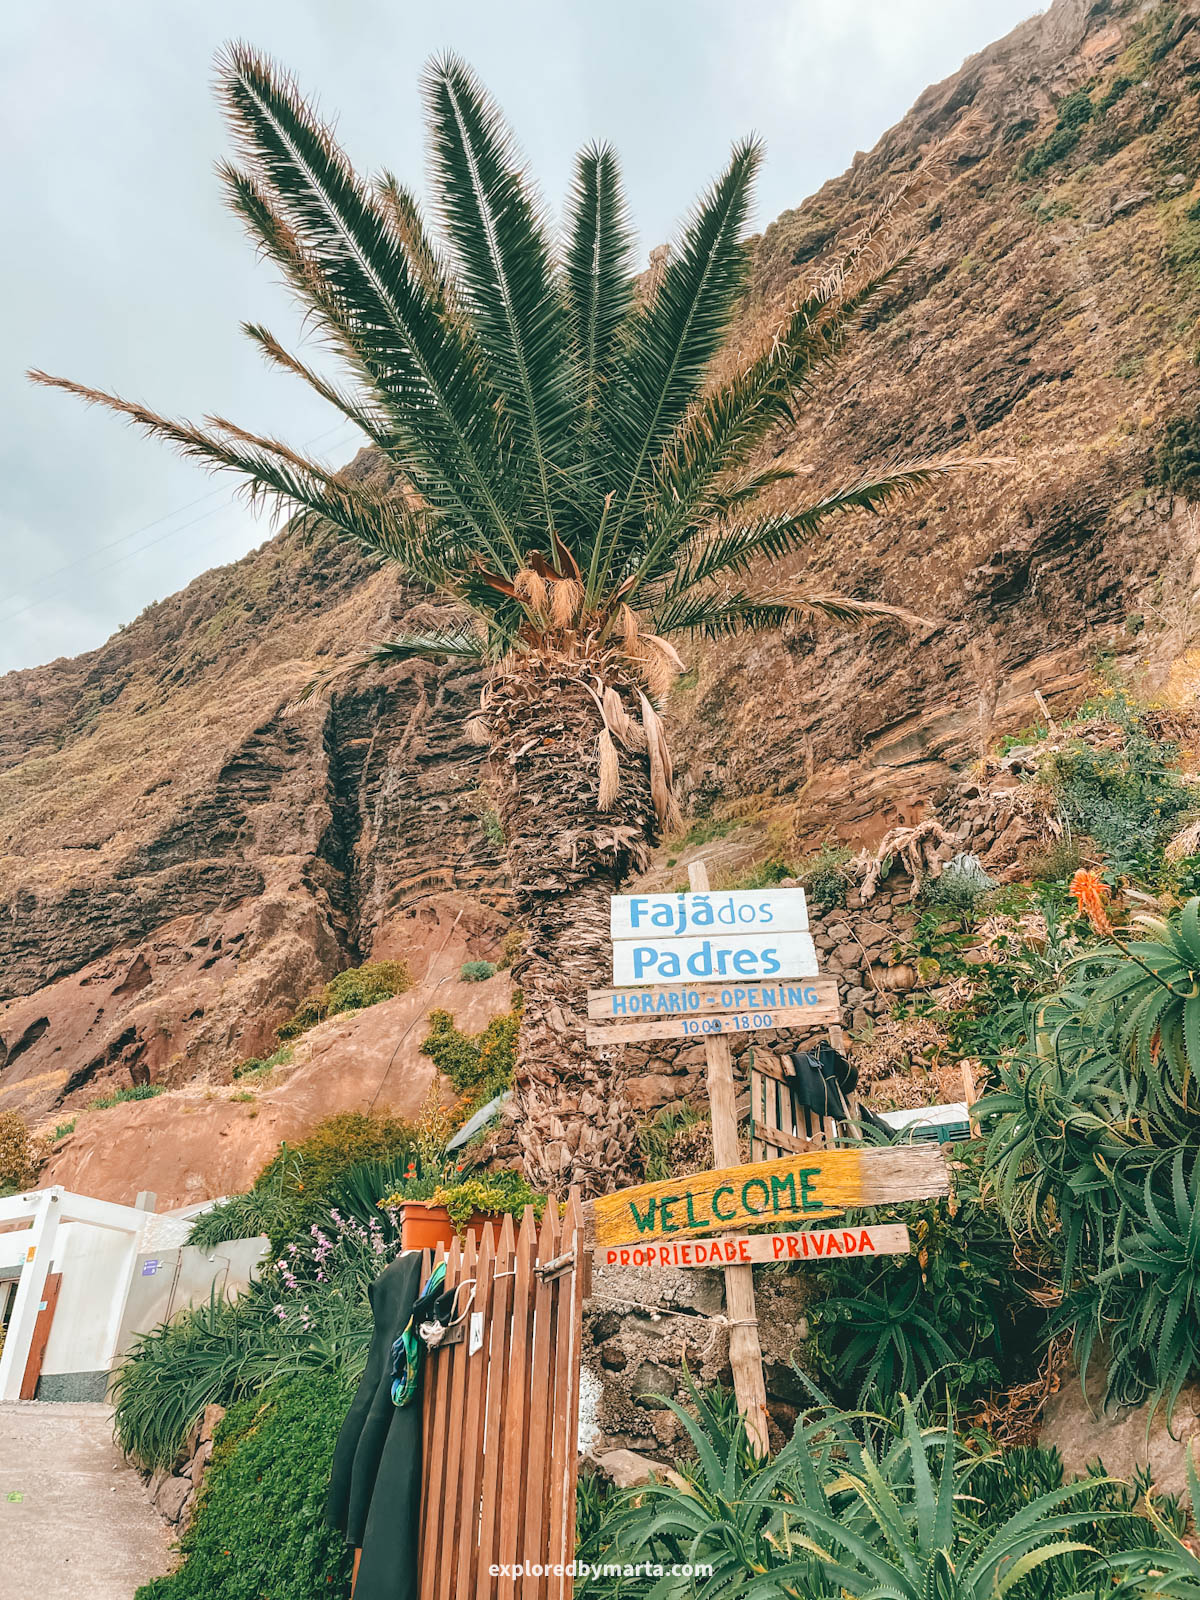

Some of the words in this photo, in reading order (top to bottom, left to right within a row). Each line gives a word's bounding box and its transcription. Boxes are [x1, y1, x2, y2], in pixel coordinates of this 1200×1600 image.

[633, 941, 781, 979] Padres
[629, 1168, 823, 1234] WELCOME
[607, 1240, 752, 1267] PROPRIEDADE
[772, 1230, 875, 1259] PRIVADA
